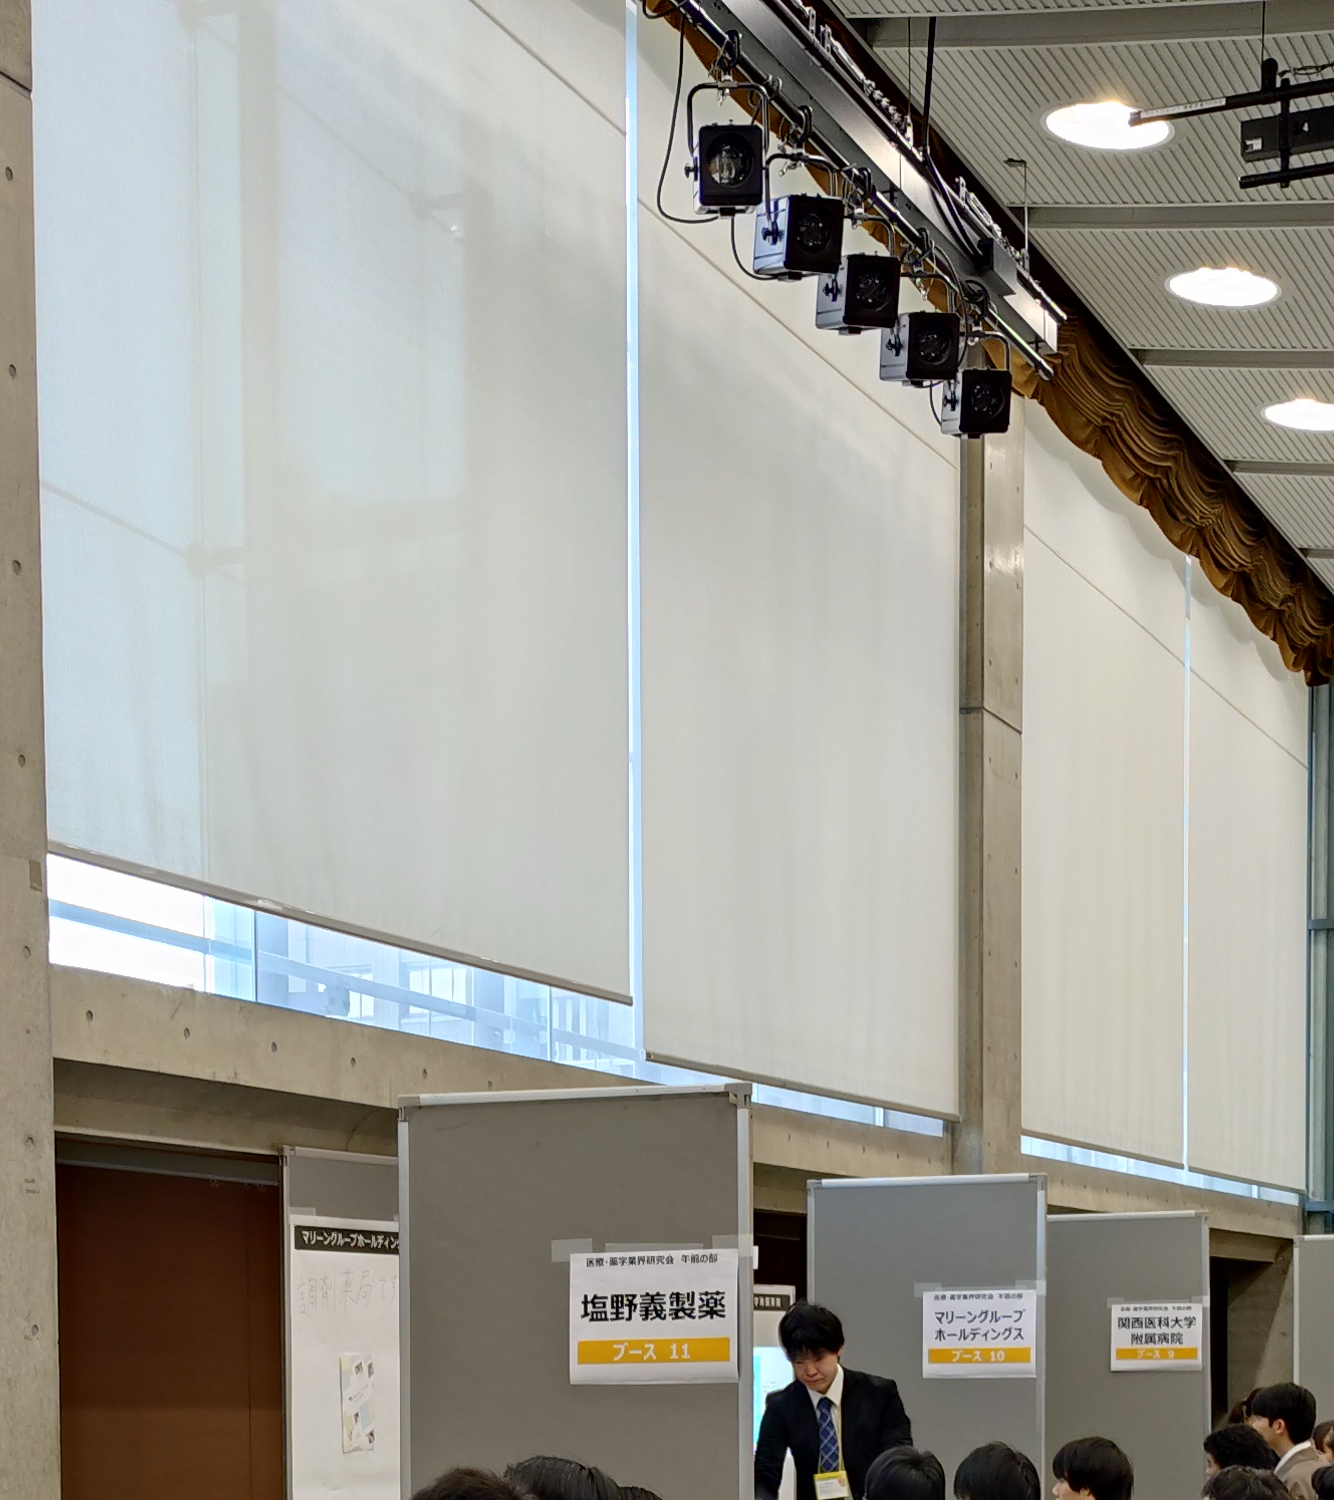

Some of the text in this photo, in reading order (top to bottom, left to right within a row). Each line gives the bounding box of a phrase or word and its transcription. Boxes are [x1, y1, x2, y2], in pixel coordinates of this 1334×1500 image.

[581, 1290, 726, 1322] 塩野義製薬
[934, 1308, 1026, 1325] マリーングループ
[1117, 1315, 1197, 1330] 関西医科大学
[934, 1326, 1024, 1342] ホールディングス
[613, 1342, 690, 1361] ブース 11
[952, 1350, 1005, 1362] ブース 10
